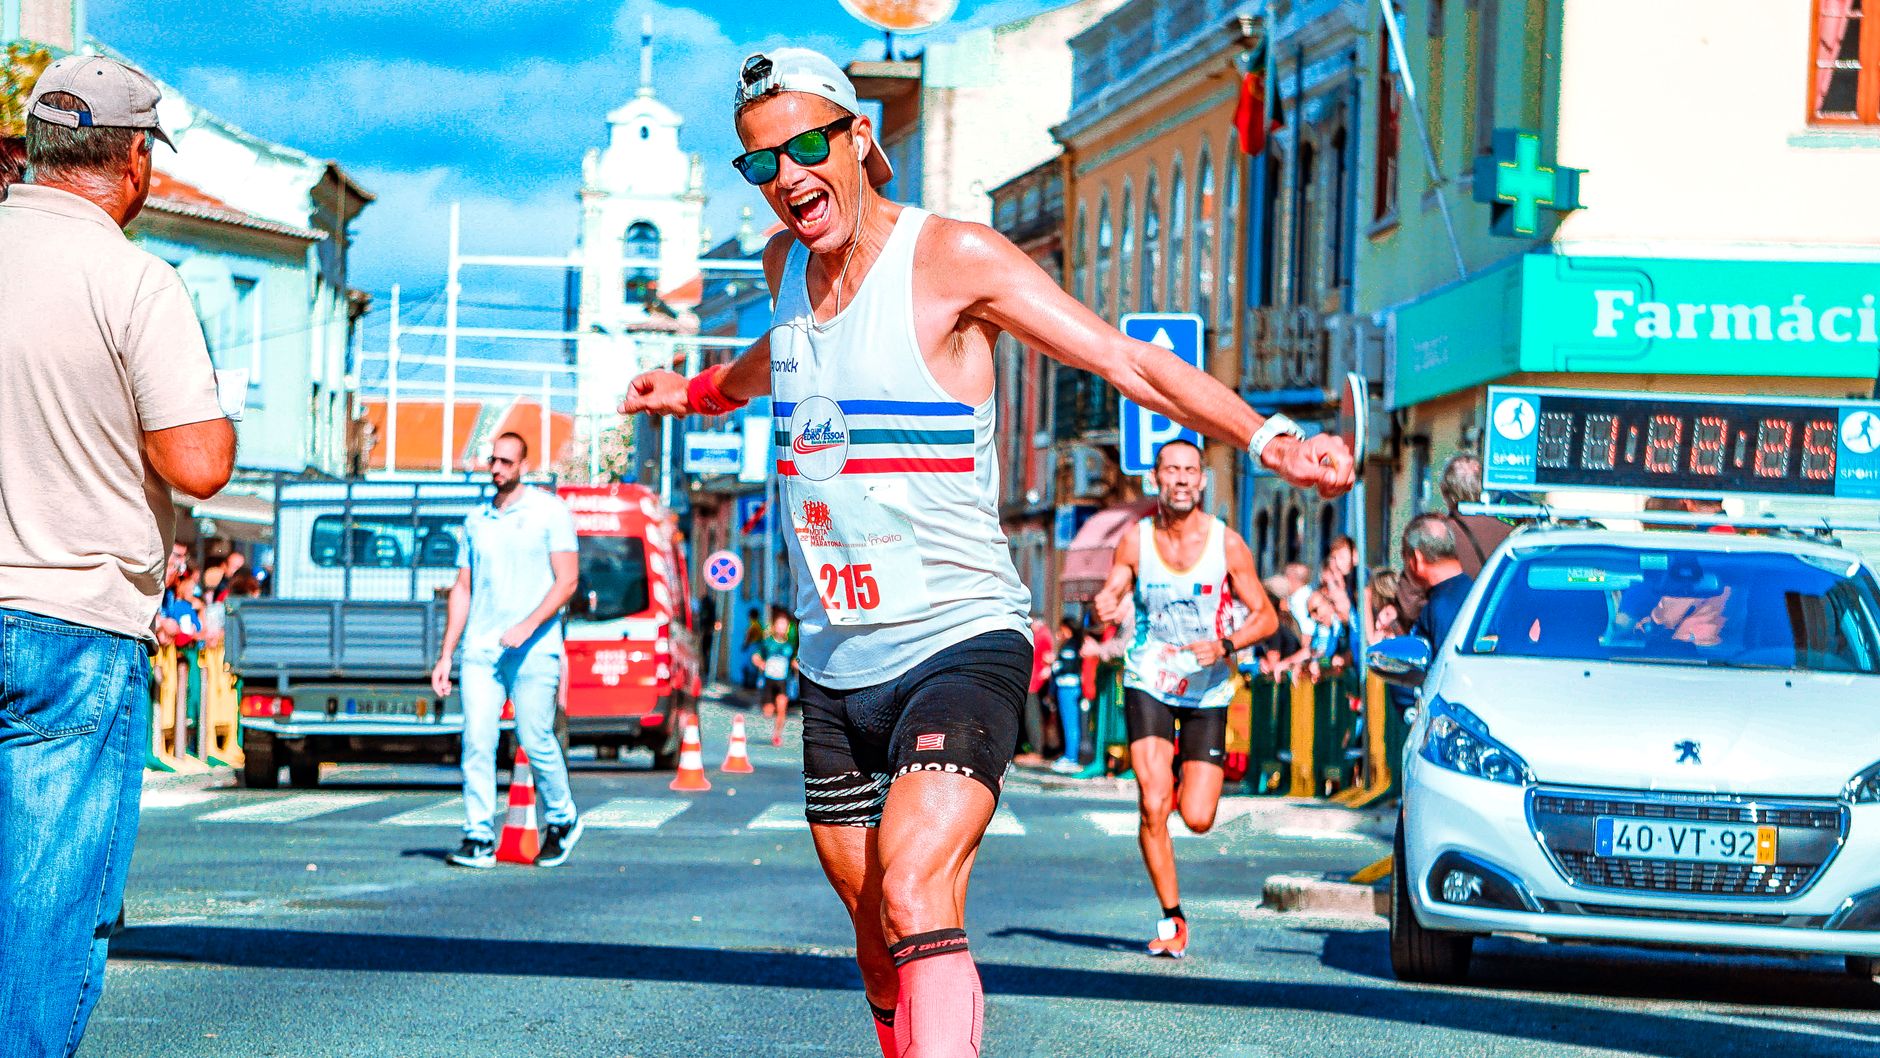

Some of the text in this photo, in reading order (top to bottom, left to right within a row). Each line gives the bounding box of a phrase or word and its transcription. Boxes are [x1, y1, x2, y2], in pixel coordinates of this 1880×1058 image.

[1593, 290, 1878, 342] Farmáci
[1493, 452, 1531, 466] SPORT
[1841, 468, 1879, 480] SPORT
[811, 540, 843, 548] MARATONA
[871, 533, 902, 545] moita
[820, 563, 880, 610] 215
